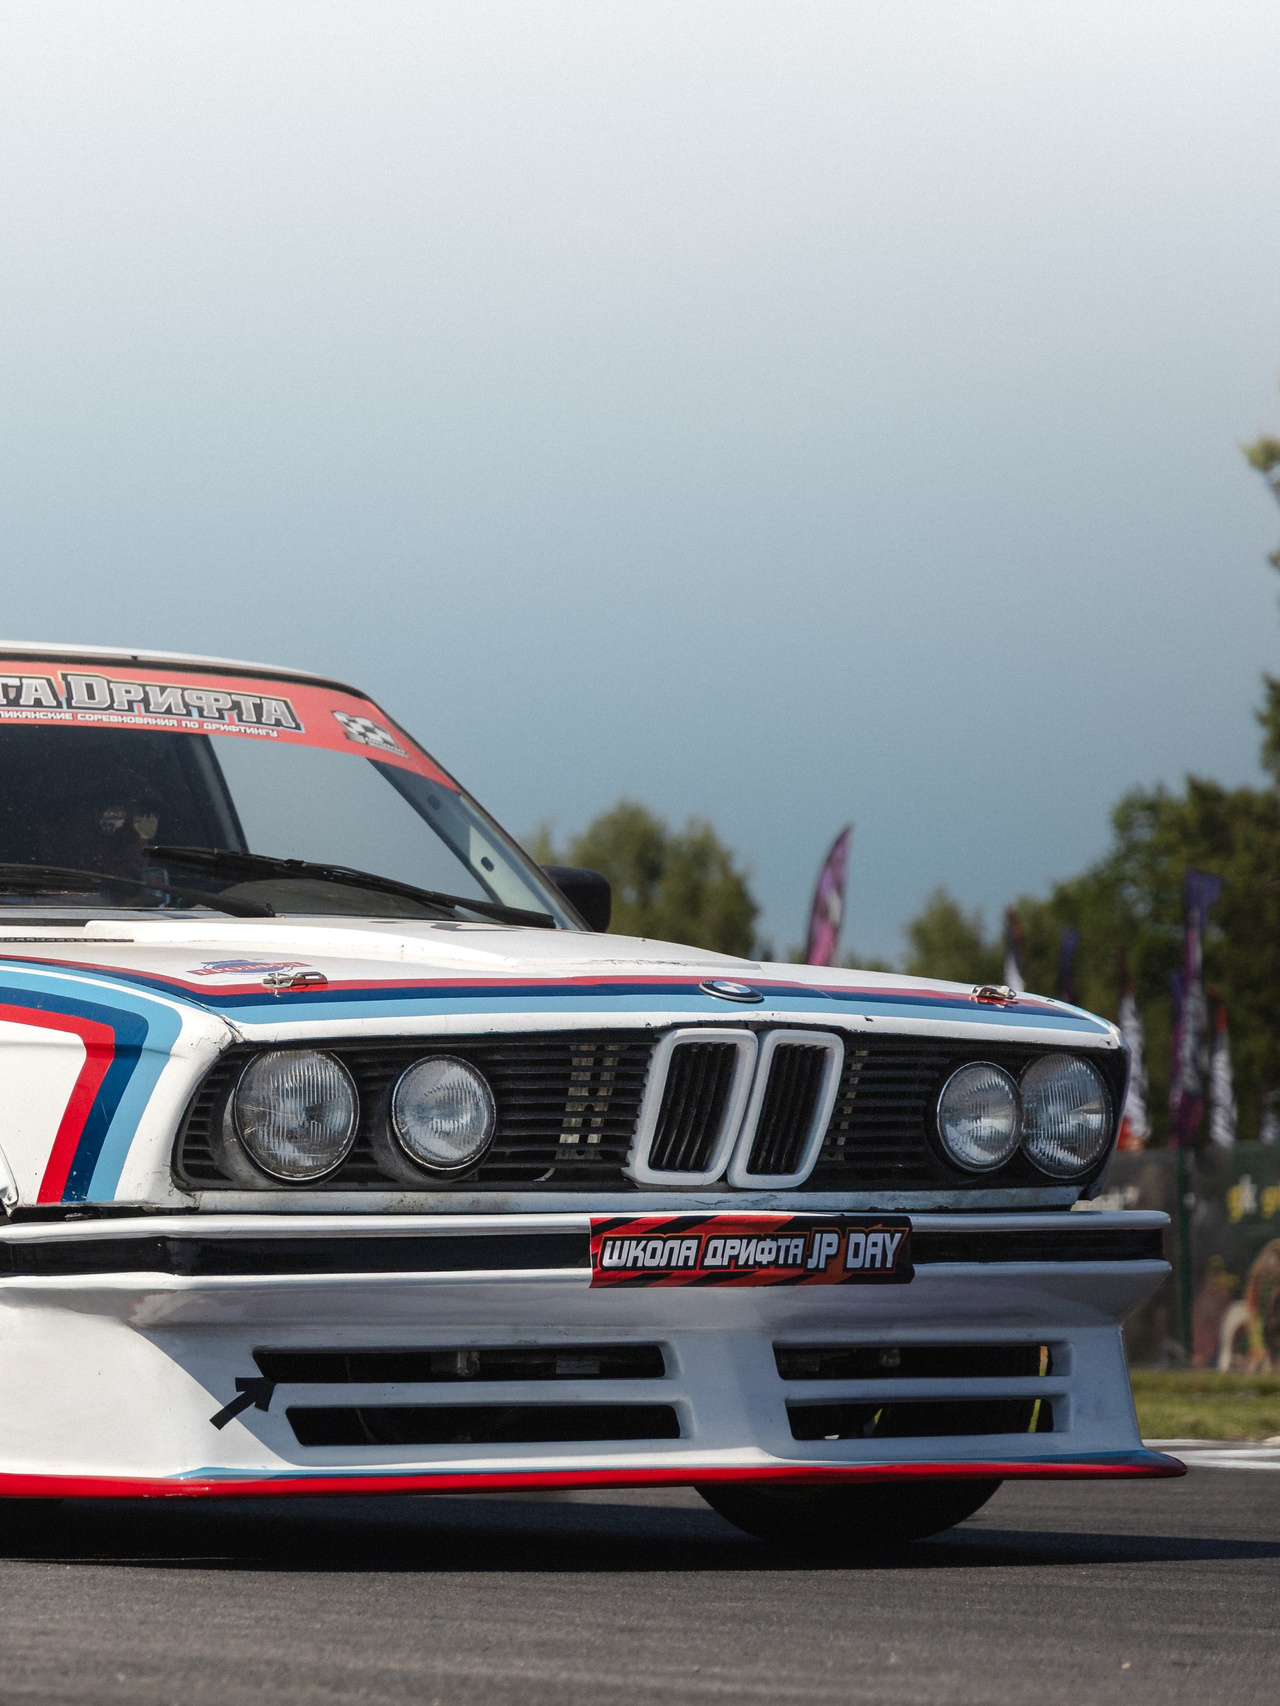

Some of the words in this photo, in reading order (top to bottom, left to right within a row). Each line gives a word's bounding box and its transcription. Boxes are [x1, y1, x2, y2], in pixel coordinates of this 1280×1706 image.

[77, 712, 179, 727] СОРЕВНОВАНИЯ
[182, 720, 200, 729] ПО
[203, 722, 279, 738] ДРИФТИНГУ
[602, 1239, 699, 1267] ШКОЛА
[704, 1237, 804, 1267] ДРИФТА
[806, 1232, 839, 1269] JP
[846, 1232, 902, 1269] DAY
